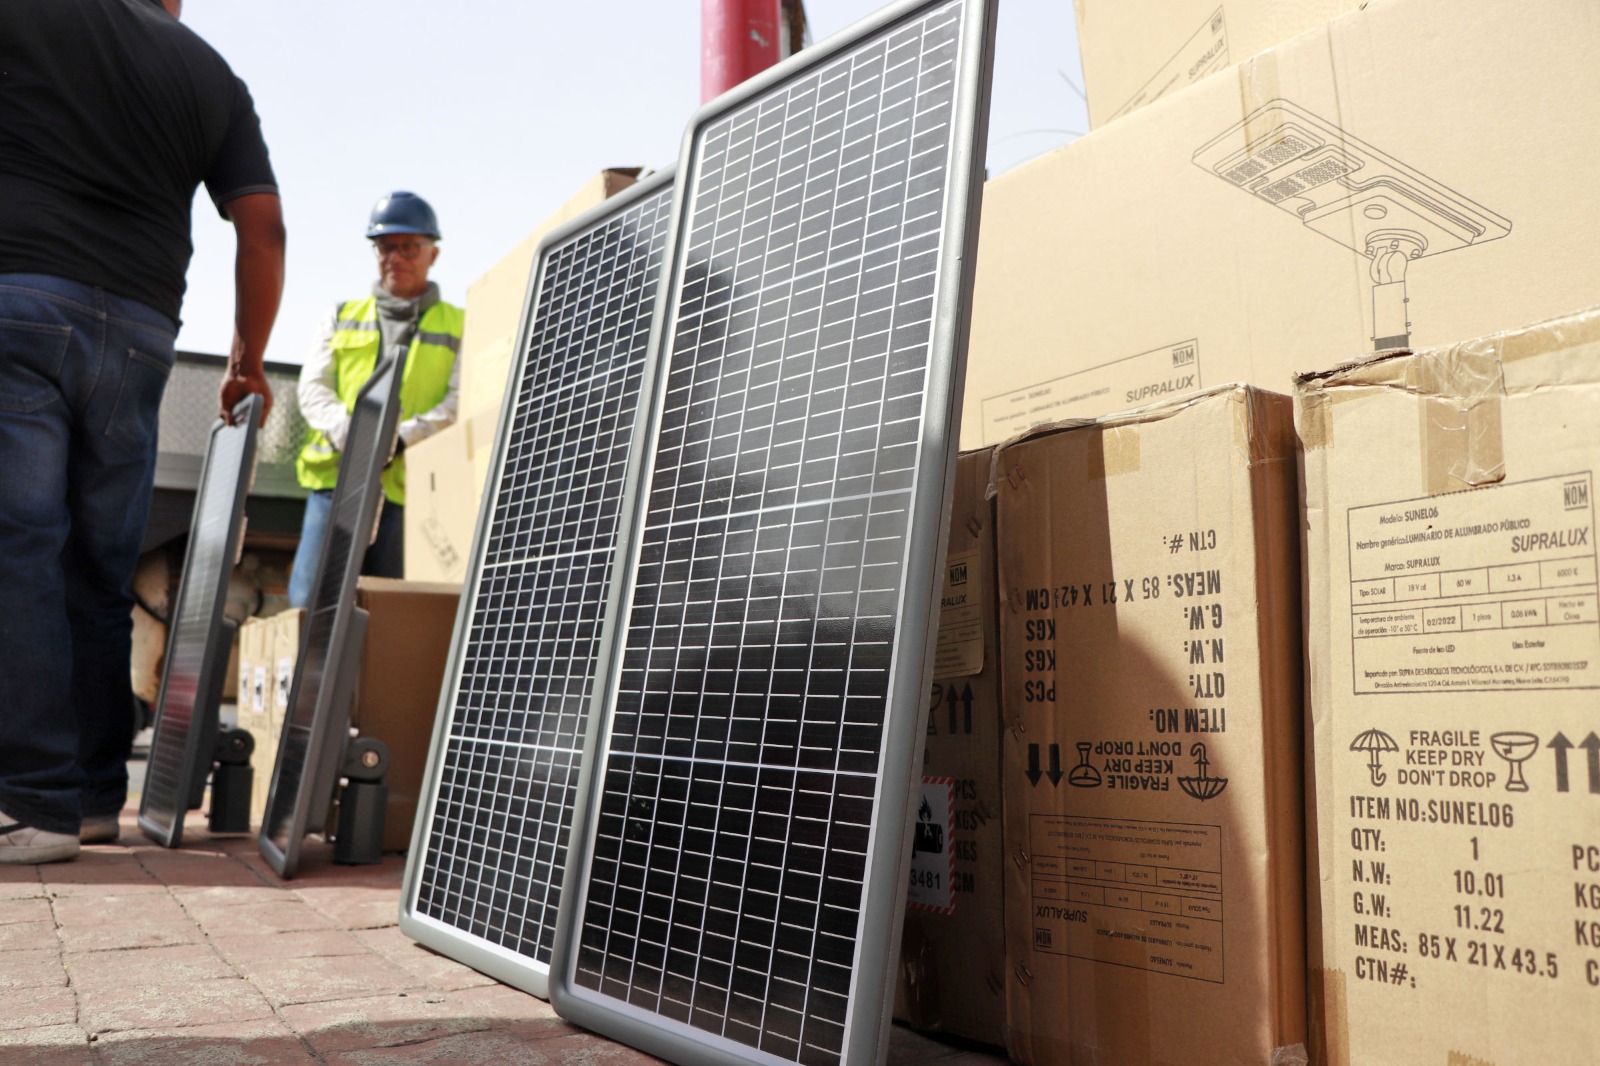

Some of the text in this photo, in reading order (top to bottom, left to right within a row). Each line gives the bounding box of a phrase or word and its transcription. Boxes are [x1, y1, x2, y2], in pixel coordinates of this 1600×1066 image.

[1172, 347, 1194, 365] NOM
[1126, 374, 1194, 403] SUPRALUX
[1564, 484, 1588, 506] NOM
[1405, 507, 1439, 522] SUNEL06
[1190, 529, 1217, 551] CTN
[1356, 540, 1379, 550] Nombre
[1444, 529, 1453, 538] DE
[1455, 523, 1498, 537] ALUMBRADO
[1500, 519, 1530, 531] PÚBLICO
[1511, 526, 1589, 553] SUPRALUX
[1406, 556, 1440, 569] SUPRALUX
[949, 566, 968, 583] NOM
[1167, 569, 1221, 598] MEAS:
[1083, 584, 1092, 606] X
[1102, 581, 1117, 605] 21
[1124, 579, 1135, 603] X
[1142, 576, 1160, 600] 85
[1026, 588, 1049, 611] CM
[1026, 603, 1223, 642] G.W: KGS
[1426, 616, 1456, 627] 02/2022
[1025, 638, 1224, 672] N.W: KGS
[1024, 672, 1225, 702] QTY: PCS
[1149, 708, 1226, 734] ITEM NO:
[1095, 741, 1182, 756] DON'T DROP
[1410, 730, 1480, 747] FRAGILE
[1103, 759, 1173, 774] KEEP DRY
[1406, 750, 1485, 767] KEEP DRY
[954, 778, 977, 800] PCS
[1107, 774, 1169, 791] FRAGILE
[1398, 769, 1496, 788] DON'T DROP
[1350, 796, 1390, 820] ITEM
[954, 809, 978, 831] KGS
[955, 840, 978, 862] KGS
[1351, 828, 1386, 852] QTY:
[1470, 836, 1479, 861] 1
[953, 872, 975, 894] CM
[1352, 859, 1392, 886] N.W:
[1453, 869, 1505, 899] 10.01
[1036, 905, 1088, 923] SUPRALUX
[1353, 891, 1391, 919] G.W:
[1453, 904, 1505, 934] 11.22
[1354, 923, 1559, 980] MEAS: 85 X 21 X 43.5
